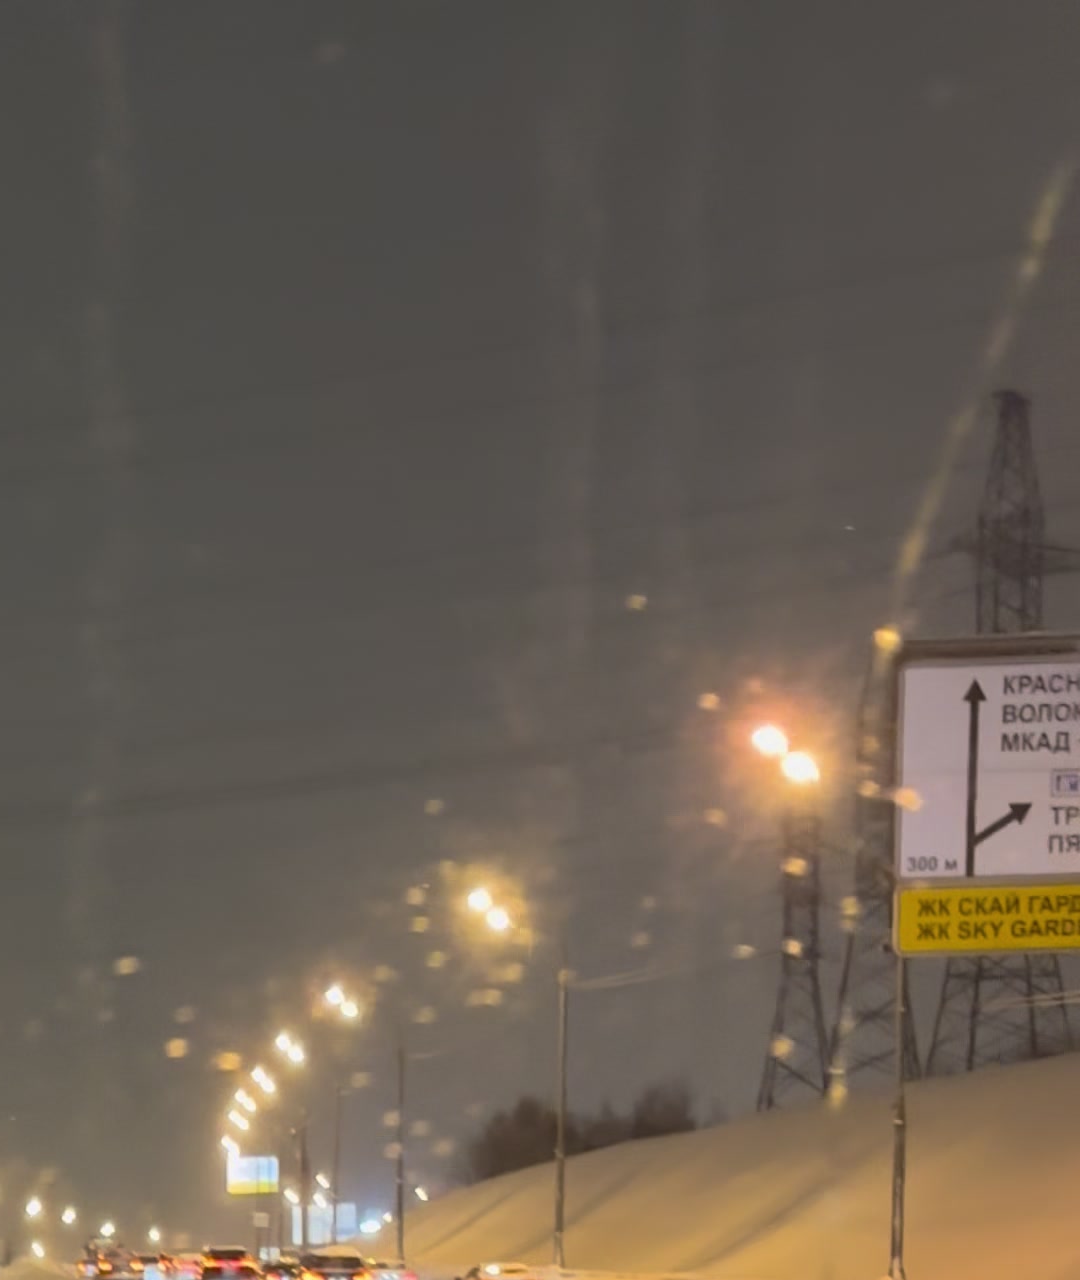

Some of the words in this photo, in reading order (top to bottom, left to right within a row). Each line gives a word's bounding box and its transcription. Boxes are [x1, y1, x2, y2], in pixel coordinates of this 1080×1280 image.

[1000, 731, 1071, 754] МКАД
[906, 856, 938, 872] 300
[917, 896, 951, 917] ЖК
[958, 892, 1019, 916] СКАЙ
[917, 921, 951, 941] ЖК
[957, 920, 1003, 939] SKY
[1010, 918, 1080, 938] GARD
